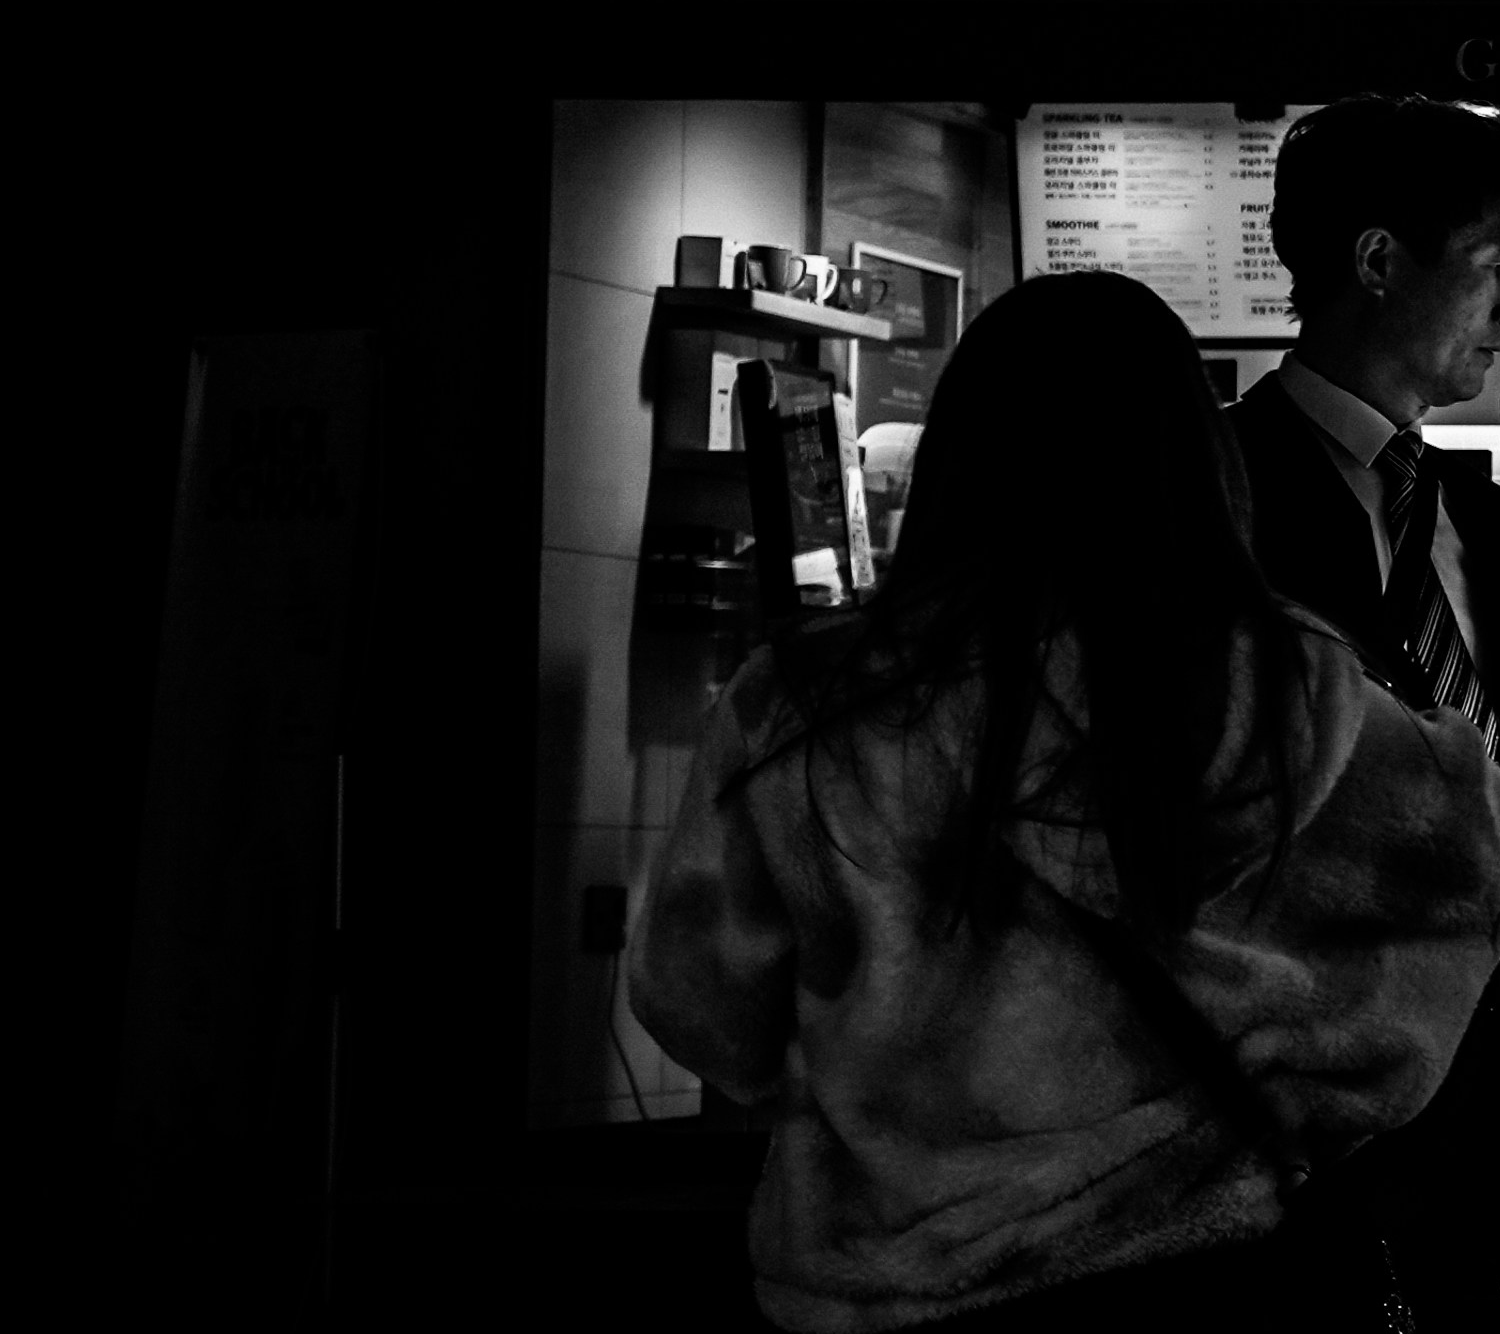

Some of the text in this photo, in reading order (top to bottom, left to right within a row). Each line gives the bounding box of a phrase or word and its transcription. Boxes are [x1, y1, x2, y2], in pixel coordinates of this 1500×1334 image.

[1045, 220, 1100, 231] SMOOTHIE
[231, 406, 327, 466] BACK
[206, 466, 344, 523] SCHOOL
